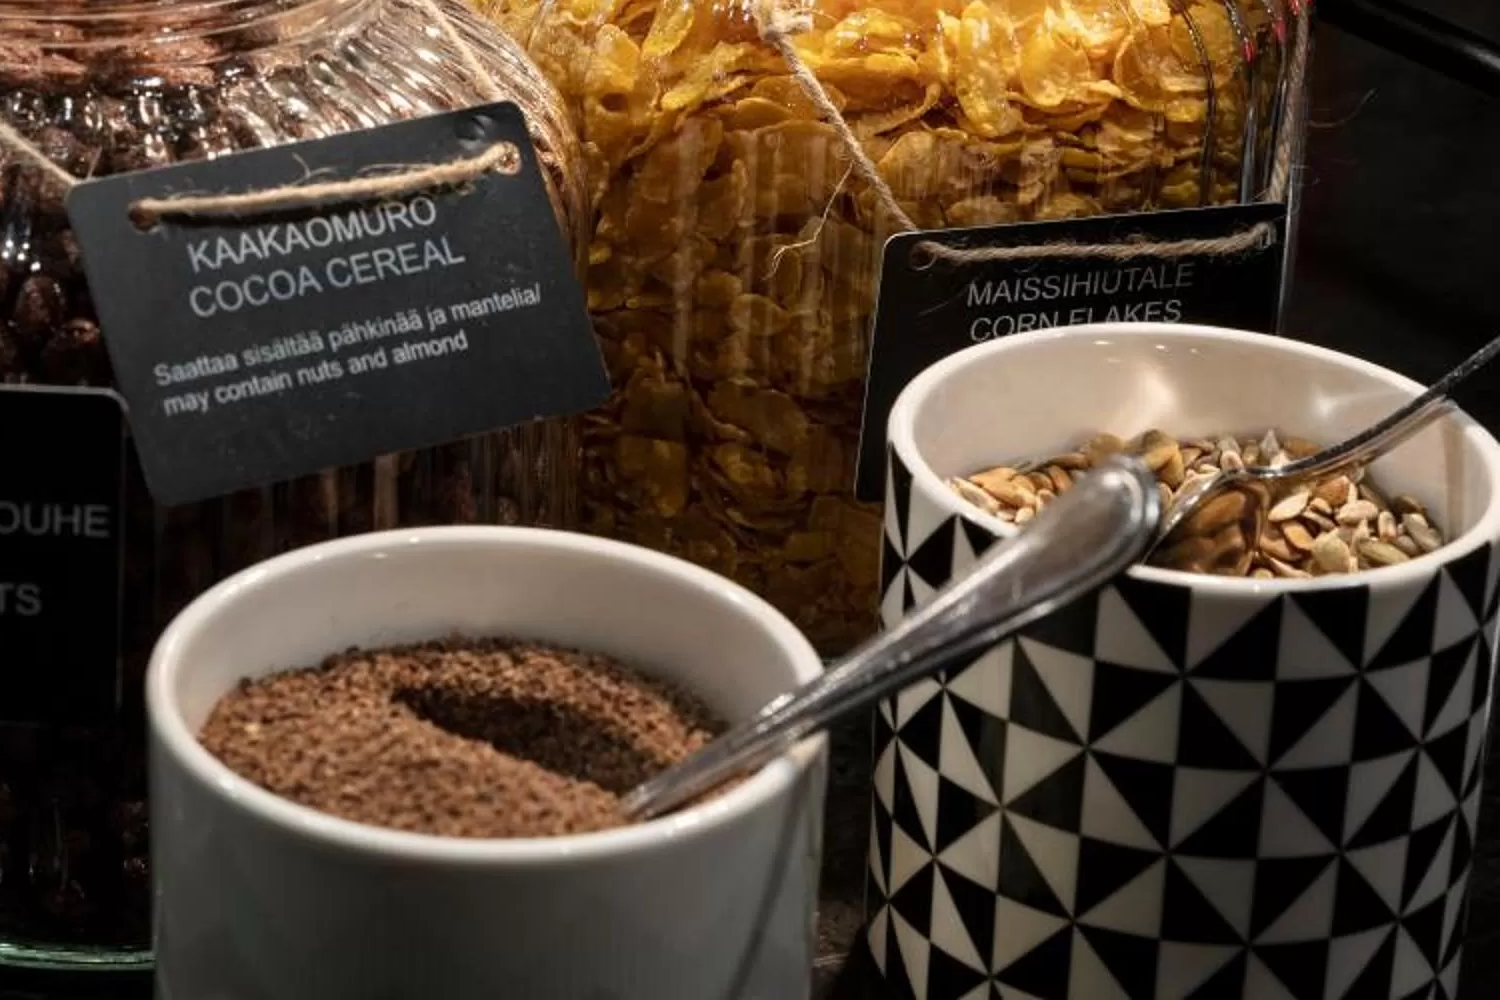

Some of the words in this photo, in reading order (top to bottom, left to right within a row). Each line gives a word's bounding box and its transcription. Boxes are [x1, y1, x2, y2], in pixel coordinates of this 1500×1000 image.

[186, 197, 437, 273] KAAKAOMURO
[188, 264, 324, 319] COCOA
[326, 235, 465, 288] CEREAL
[966, 262, 1196, 308] MAISSIHIUTALE
[153, 352, 239, 387] Saattaa
[243, 330, 323, 368] sisältää
[330, 308, 423, 353] pähkinää
[427, 305, 447, 333] ja
[970, 311, 1060, 343] CORN
[163, 388, 210, 417] may
[215, 370, 292, 405] contain
[297, 358, 343, 385] nuts
[349, 349, 387, 374] and
[392, 330, 469, 364] almond
